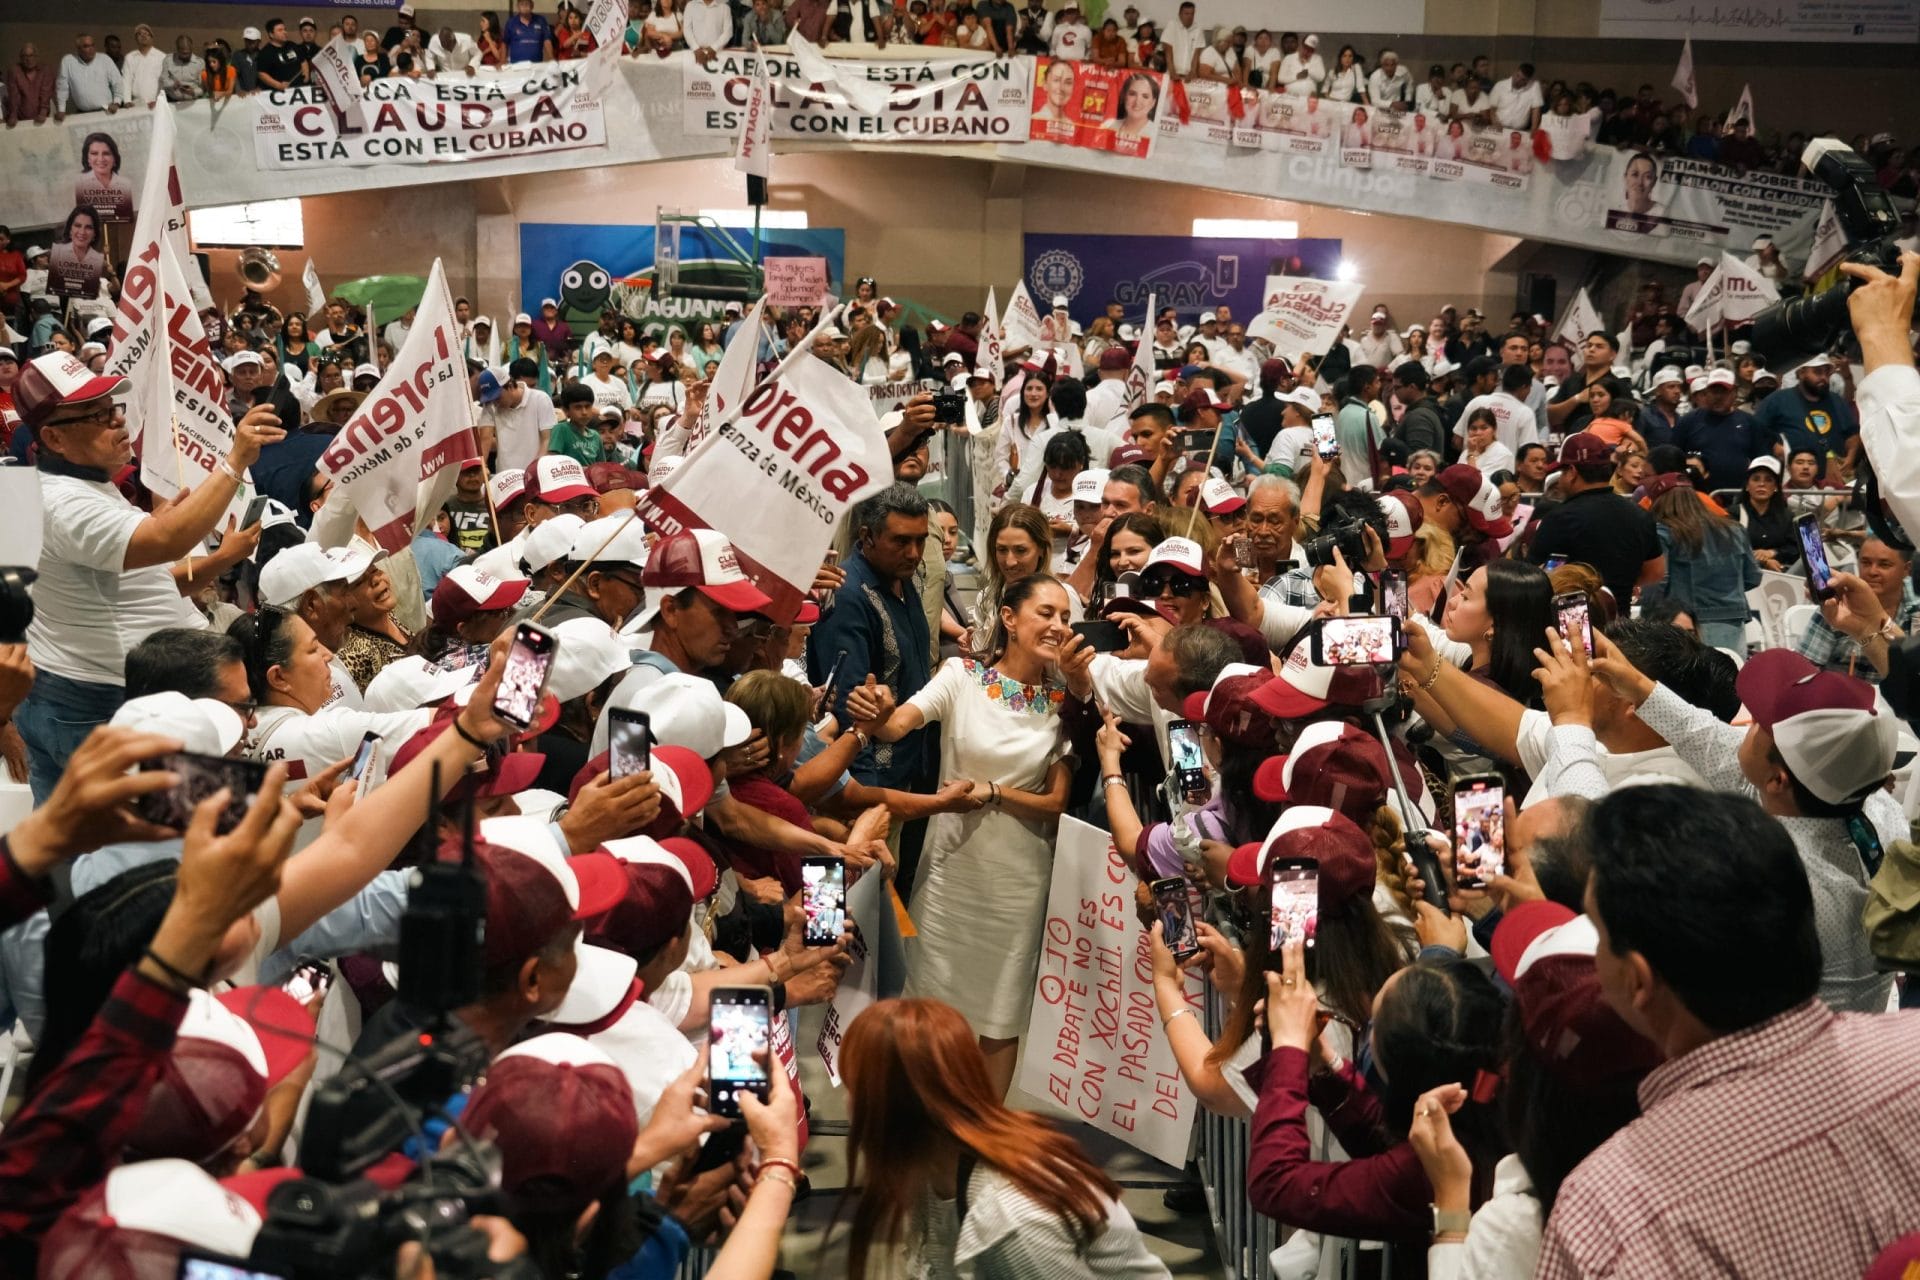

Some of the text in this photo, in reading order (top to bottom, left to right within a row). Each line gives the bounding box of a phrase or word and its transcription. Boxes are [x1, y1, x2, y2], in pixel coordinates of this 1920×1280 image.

[704, 57, 1009, 82] CABOR ESTÁ CON
[269, 83, 412, 106] CABCA
[723, 77, 989, 112] CLADIA
[293, 94, 563, 137] CLAUDIA
[790, 115, 848, 133] CON
[859, 117, 889, 134] EL
[893, 117, 1010, 135] CUBANO
[278, 122, 587, 161] ESTÁ CON EL CUBANO
[1661, 172, 1678, 184] AL
[1750, 172, 1798, 190] SOBRE
[1049, 266, 1065, 277] 25
[1115, 281, 1209, 305] GARAY
[178, 423, 218, 453] HACIENDO
[759, 452, 778, 478] de
[778, 468, 834, 526] México
[450, 511, 490, 530] UFC
[1040, 916, 1072, 1005] OJO
[1049, 898, 1098, 1106] EL DEBATE NO ES
[1077, 1059, 1108, 1120] CON
[1100, 892, 1124, 932] ES
[1118, 990, 1155, 1083] PASADO
[1152, 1066, 1181, 1121] DEL
[1112, 1098, 1137, 1132] EL
